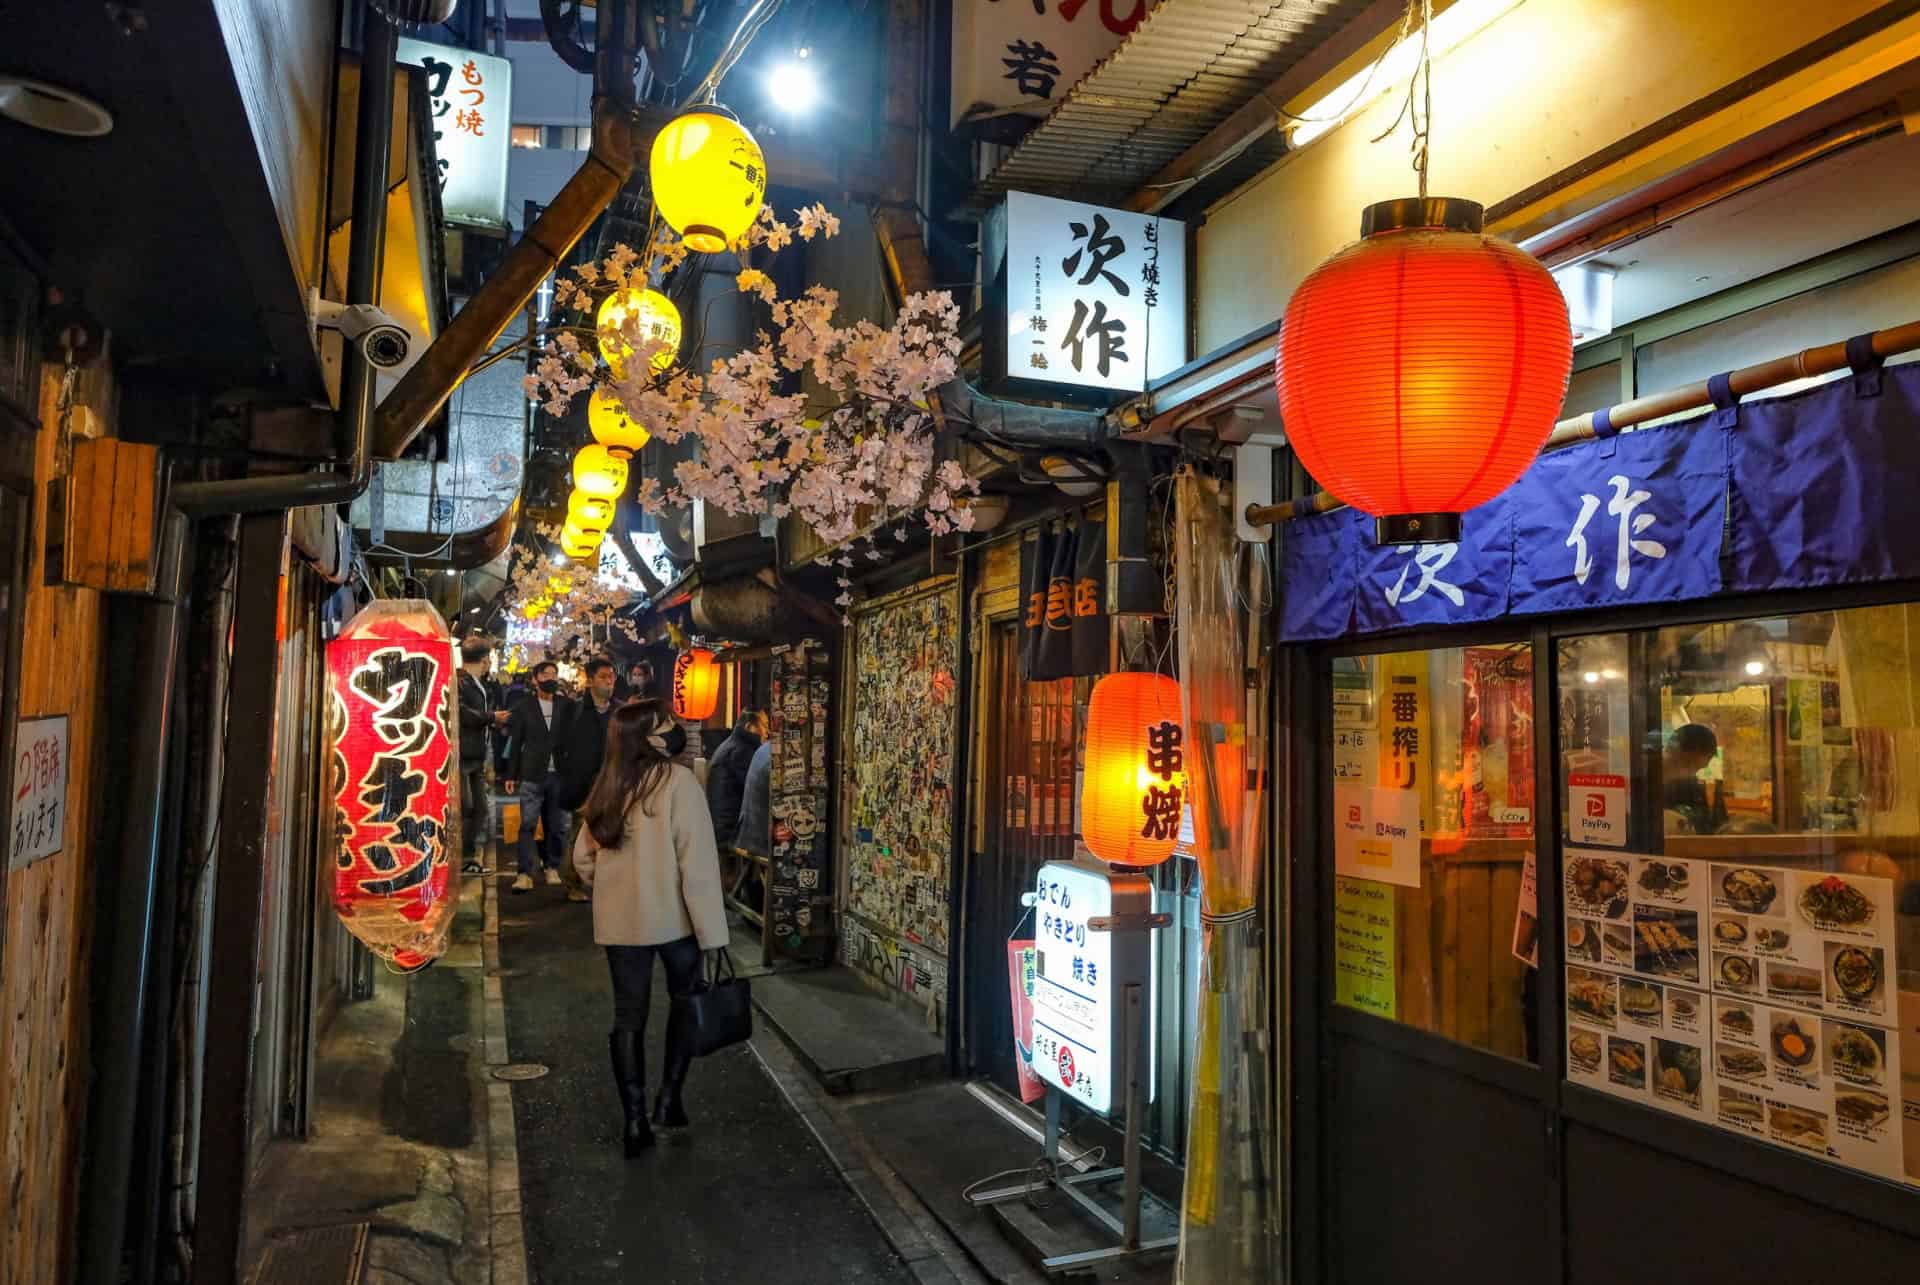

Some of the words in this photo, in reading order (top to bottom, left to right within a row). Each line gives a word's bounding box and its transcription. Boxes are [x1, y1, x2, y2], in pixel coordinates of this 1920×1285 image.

[456, 59, 485, 137] もつ焼
[1060, 213, 1131, 378] 次作
[1141, 222, 1161, 308] もつ焼き
[1391, 675, 1419, 791] 一番搾り
[1141, 720, 1182, 841] 串焼
[1582, 818, 1612, 831] PayPay
[1038, 879, 1072, 910] おでん
[1042, 911, 1086, 949] やきとり
